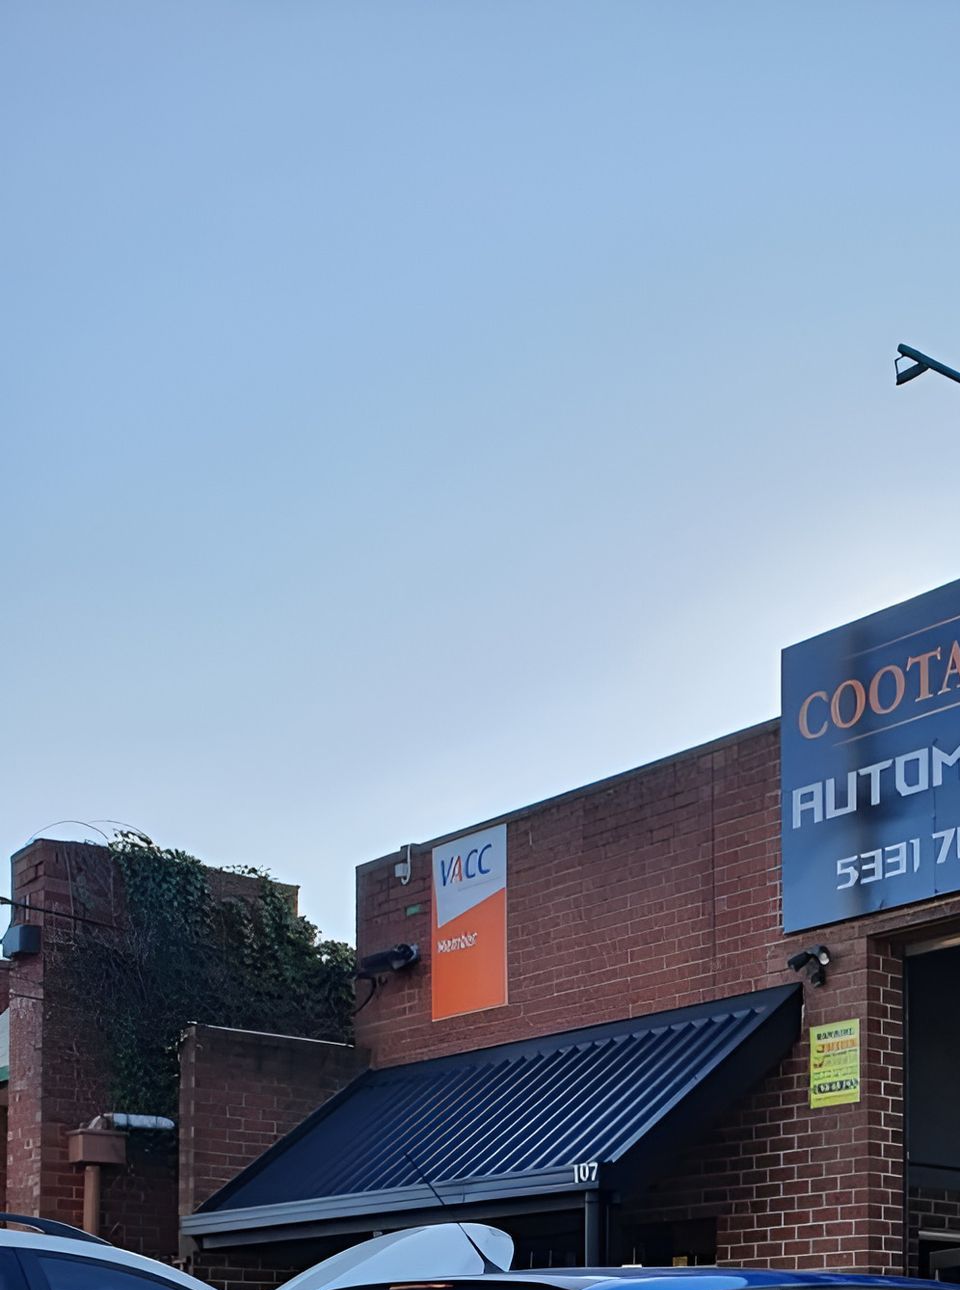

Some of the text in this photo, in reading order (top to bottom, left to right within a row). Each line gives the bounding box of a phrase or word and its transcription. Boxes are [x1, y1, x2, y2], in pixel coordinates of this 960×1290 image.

[441, 844, 492, 887] VACC
[837, 838, 920, 890] 5331
[574, 1162, 598, 1183] 107
